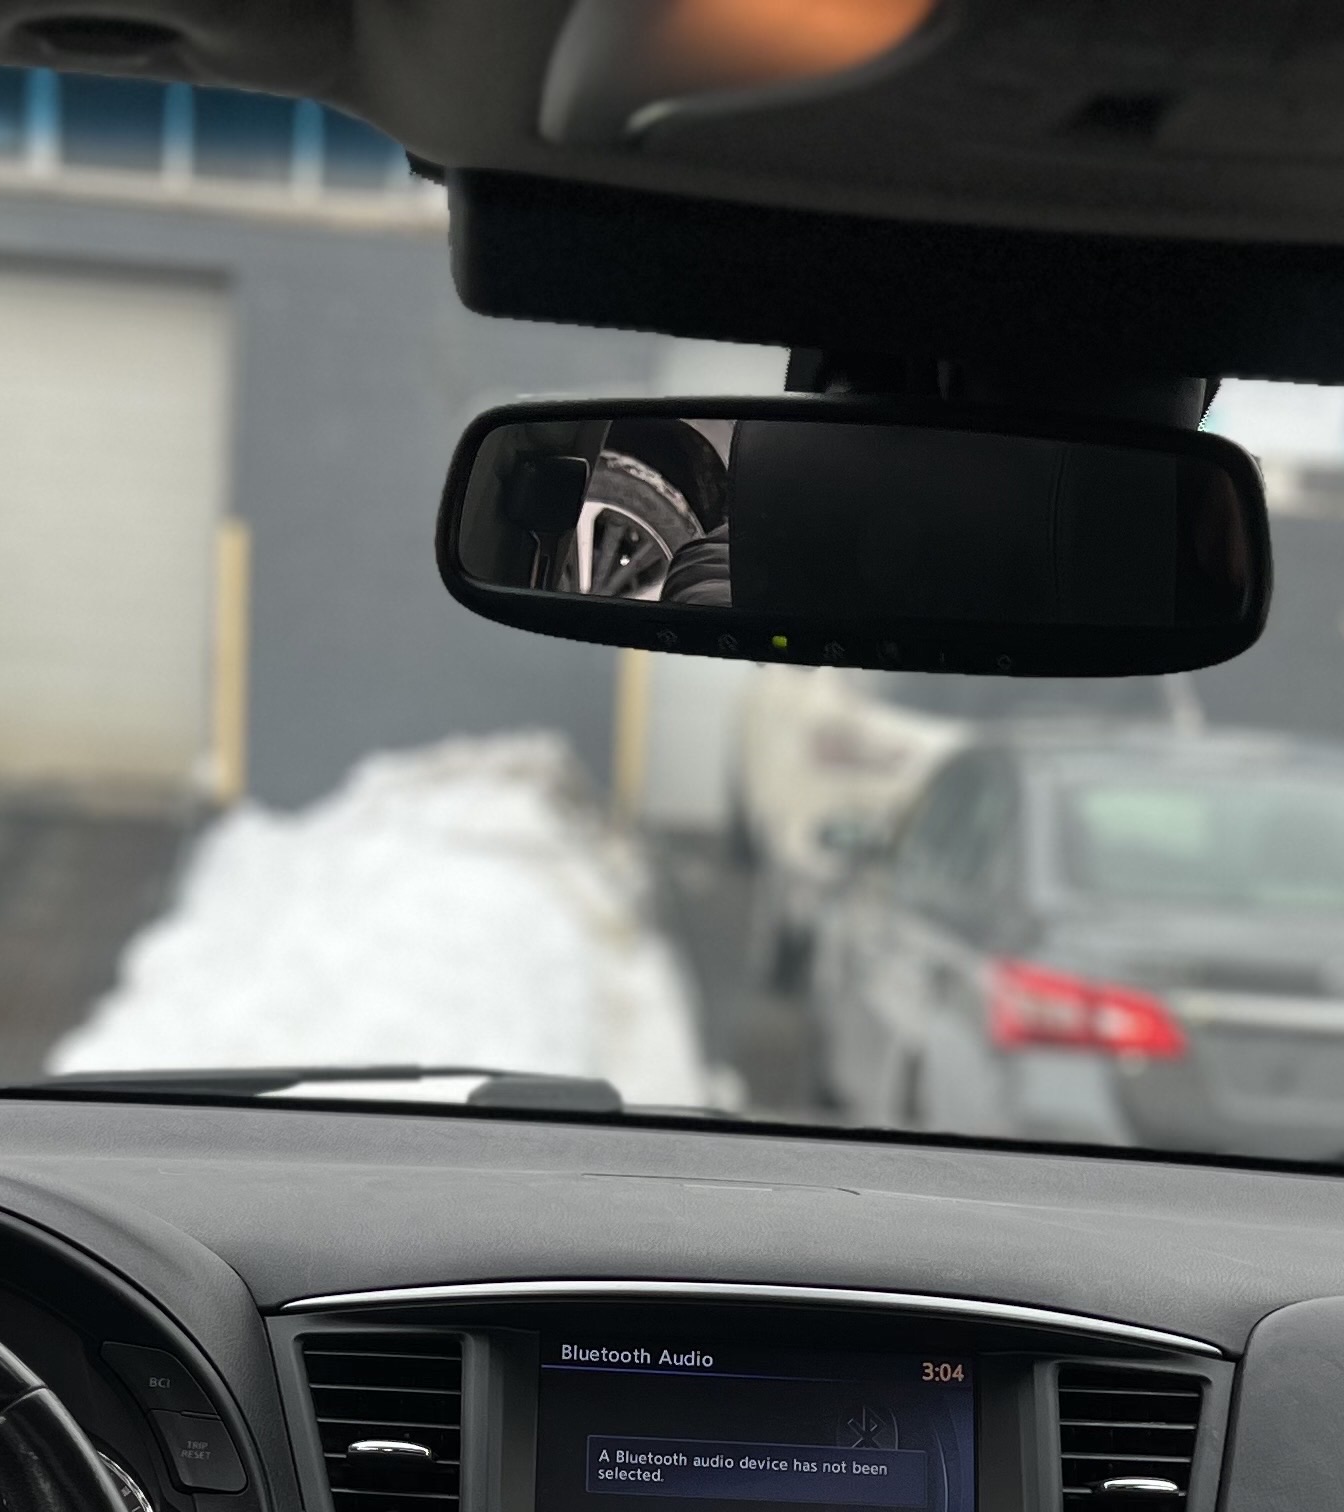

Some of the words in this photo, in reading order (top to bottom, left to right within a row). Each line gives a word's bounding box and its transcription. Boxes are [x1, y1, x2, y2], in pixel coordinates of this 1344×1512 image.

[561, 1344, 652, 1366] Bluetooth
[658, 1349, 714, 1368] Audio
[921, 1362, 965, 1383] 3:04
[148, 1376, 171, 1389] BCI
[186, 1440, 209, 1450] TRIP
[180, 1450, 212, 1460] RESET
[598, 1449, 610, 1464] A
[615, 1450, 688, 1468] Bluetooth
[692, 1454, 734, 1469] audio
[739, 1455, 789, 1472] device
[792, 1458, 818, 1474] has
[821, 1461, 848, 1475] not
[851, 1460, 888, 1476] been
[597, 1466, 665, 1483] selected.
